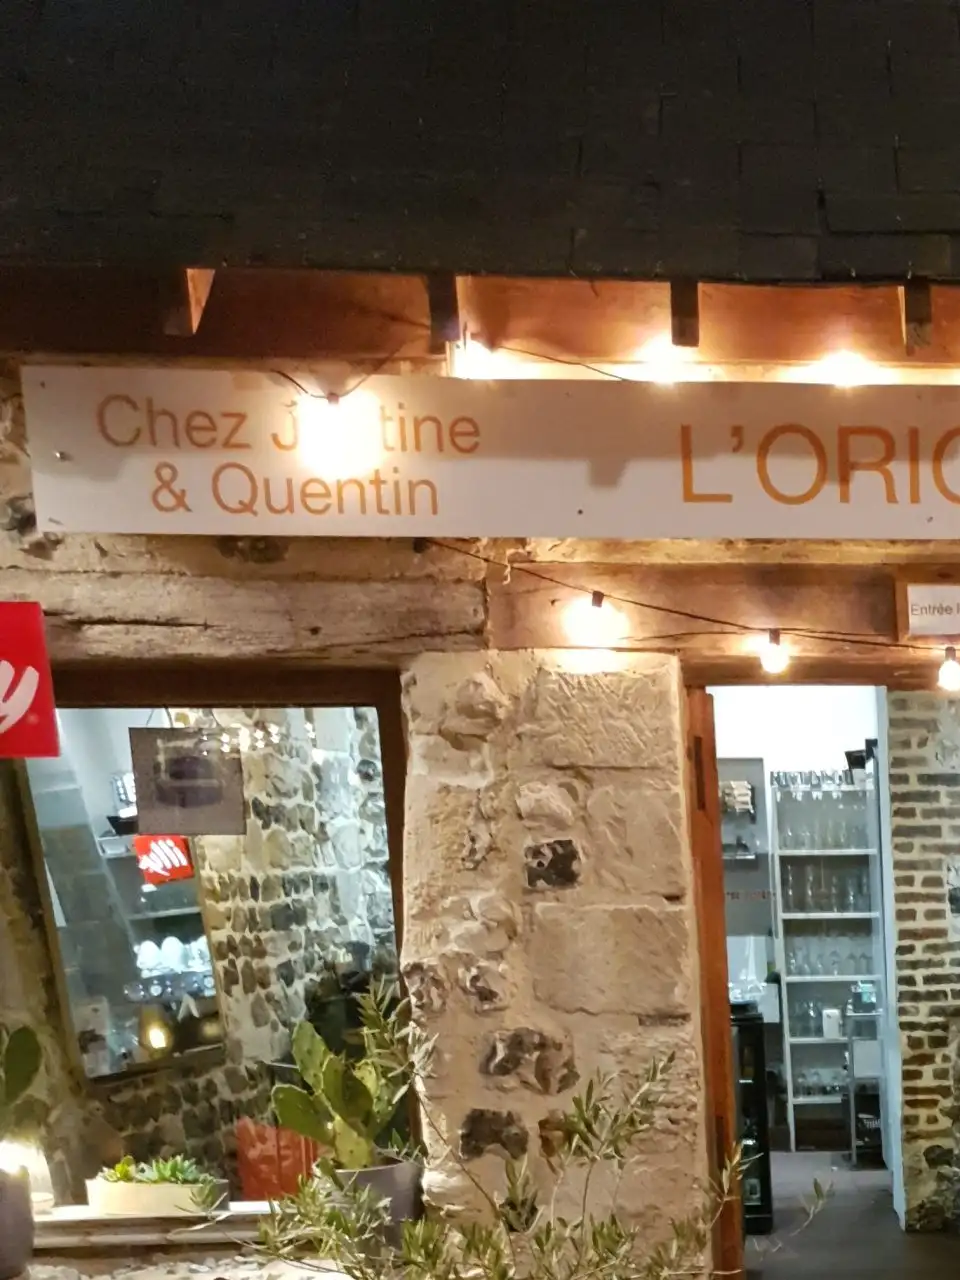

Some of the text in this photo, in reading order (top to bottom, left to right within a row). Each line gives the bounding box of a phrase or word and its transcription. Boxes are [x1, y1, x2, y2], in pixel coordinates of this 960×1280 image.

[97, 394, 481, 452] Chez Jtine
[151, 462, 439, 516] & Quentin
[910, 602, 953, 616] Entrée
